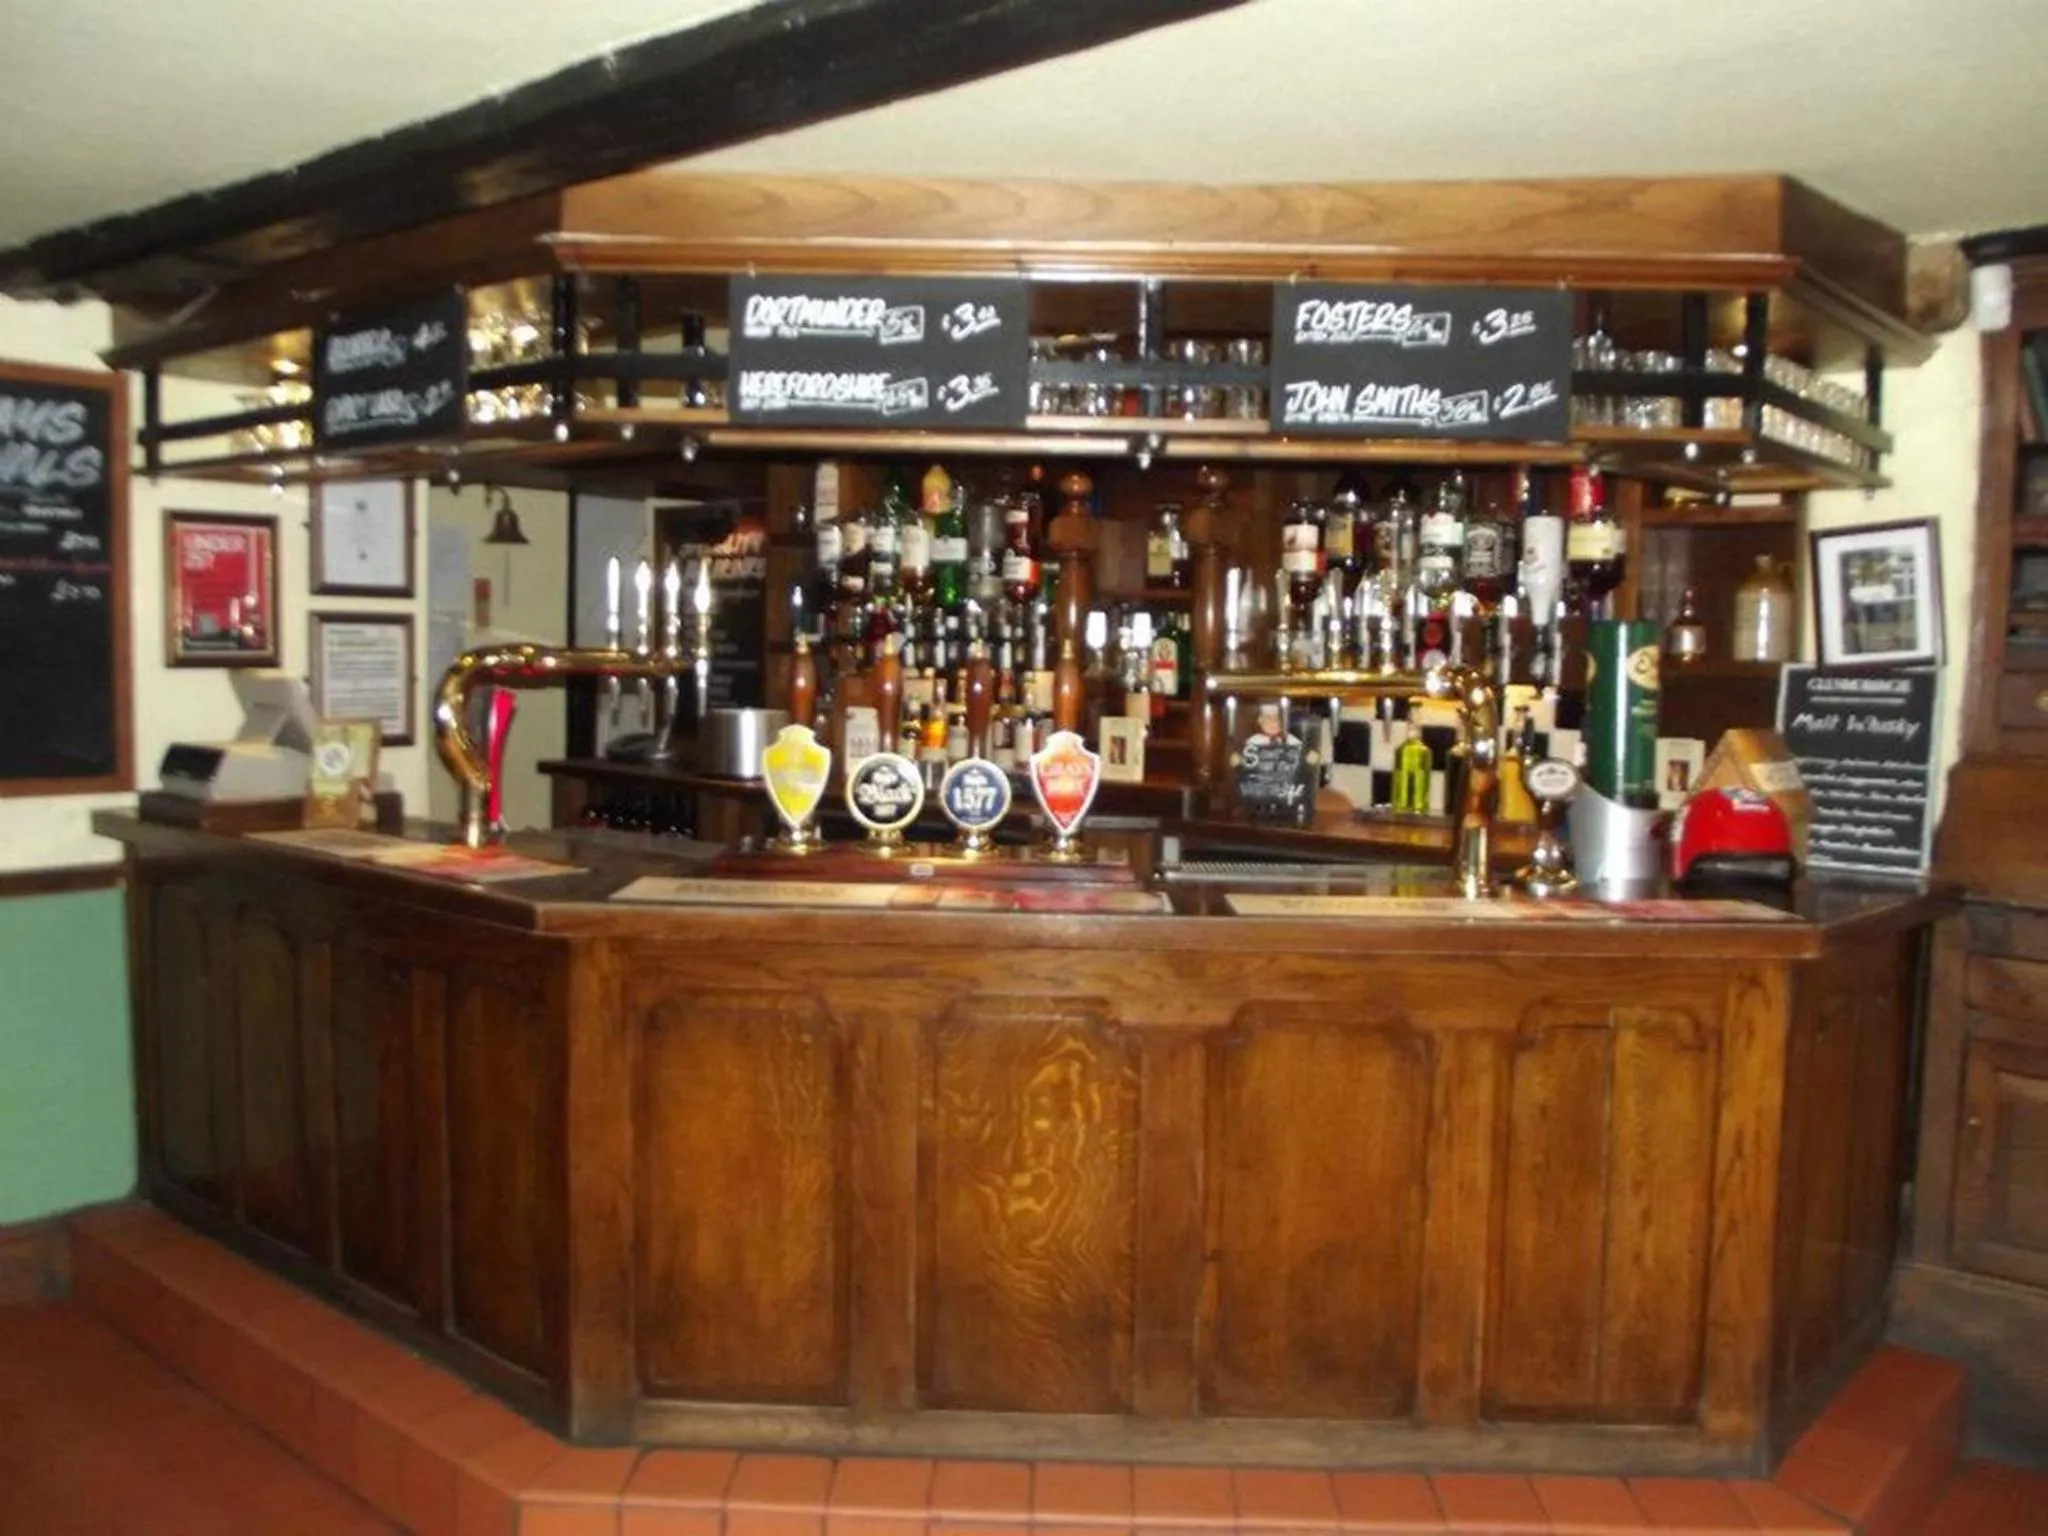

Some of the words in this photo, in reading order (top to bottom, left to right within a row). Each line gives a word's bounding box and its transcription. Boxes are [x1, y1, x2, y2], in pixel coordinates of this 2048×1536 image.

[1296, 300, 1413, 331] FOSTERS
[1285, 381, 1351, 416] JOHN
[1353, 384, 1442, 418] SMITHS
[1791, 713, 1839, 732] Malt
